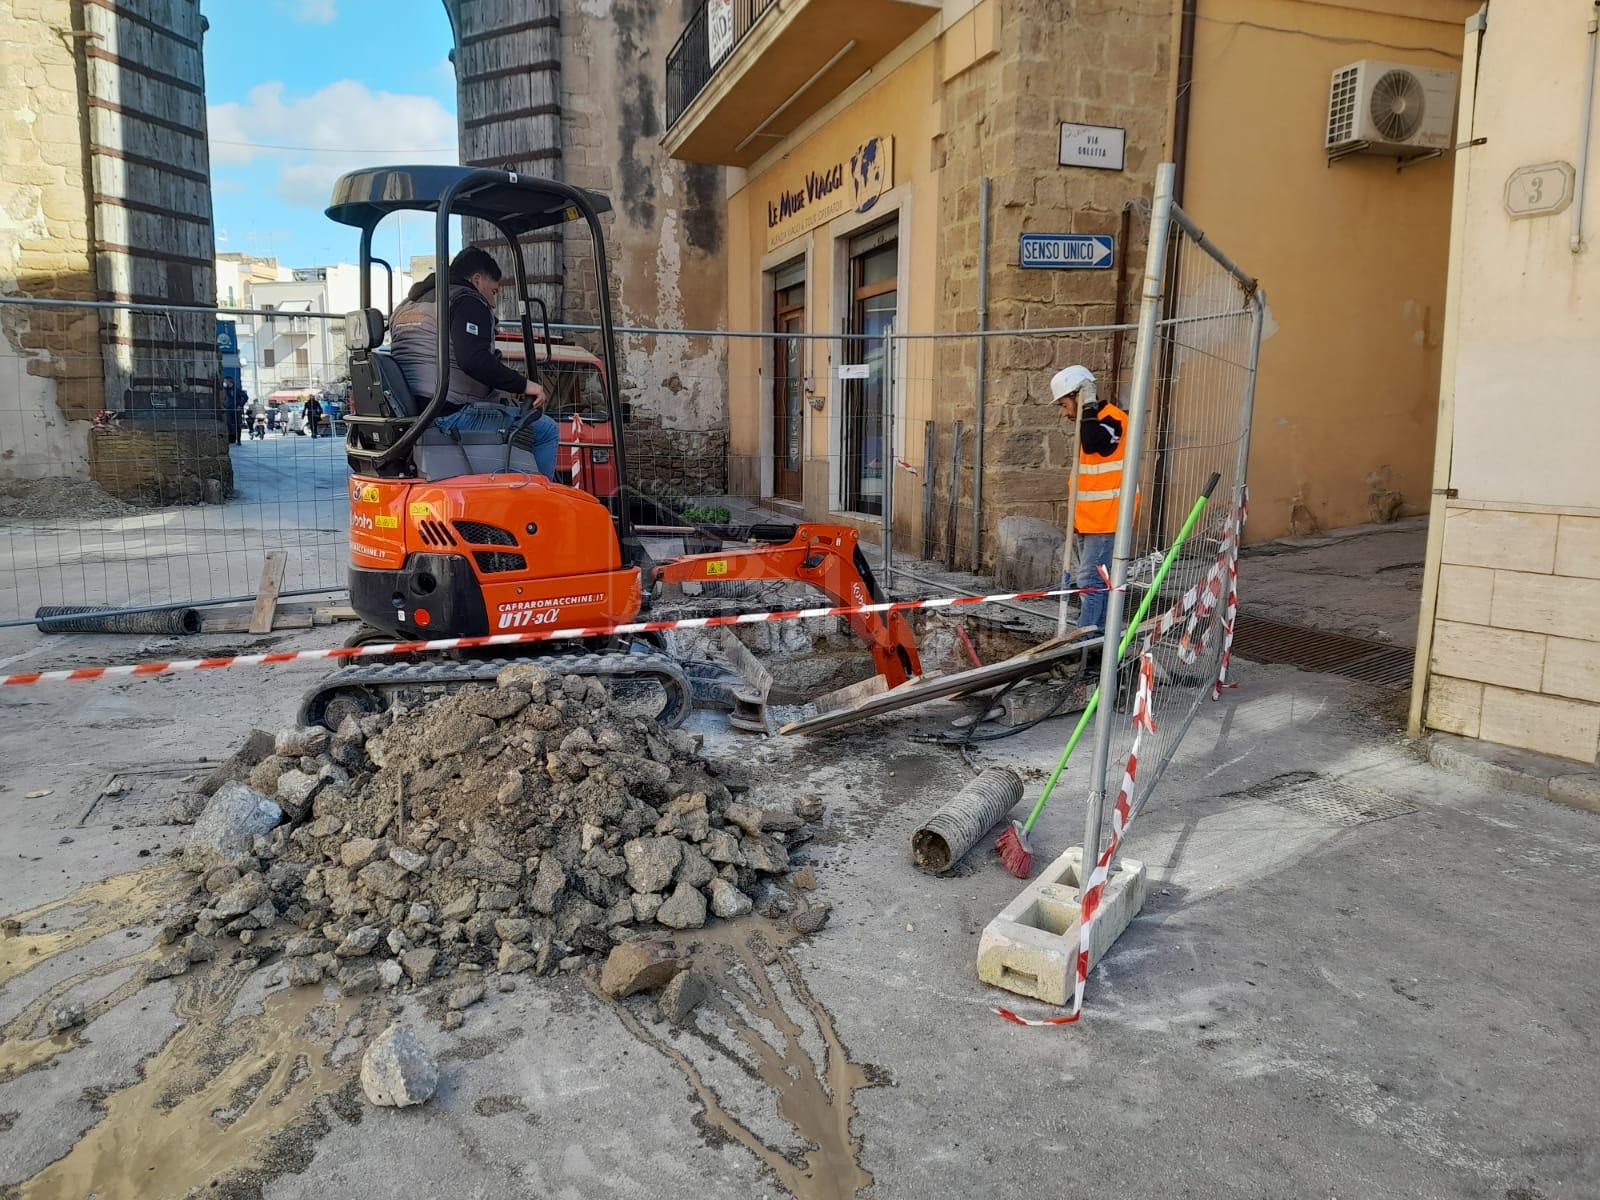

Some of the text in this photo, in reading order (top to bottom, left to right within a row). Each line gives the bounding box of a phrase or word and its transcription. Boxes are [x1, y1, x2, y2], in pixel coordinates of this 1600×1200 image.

[1087, 135, 1099, 145] VIA
[768, 200, 778, 228] LE
[805, 163, 843, 204] VIAGGI
[1528, 176, 1543, 204] 3
[1024, 241, 1094, 260] SENSO UNICO
[498, 593, 604, 612] CAFRAROMACCHINE.IT
